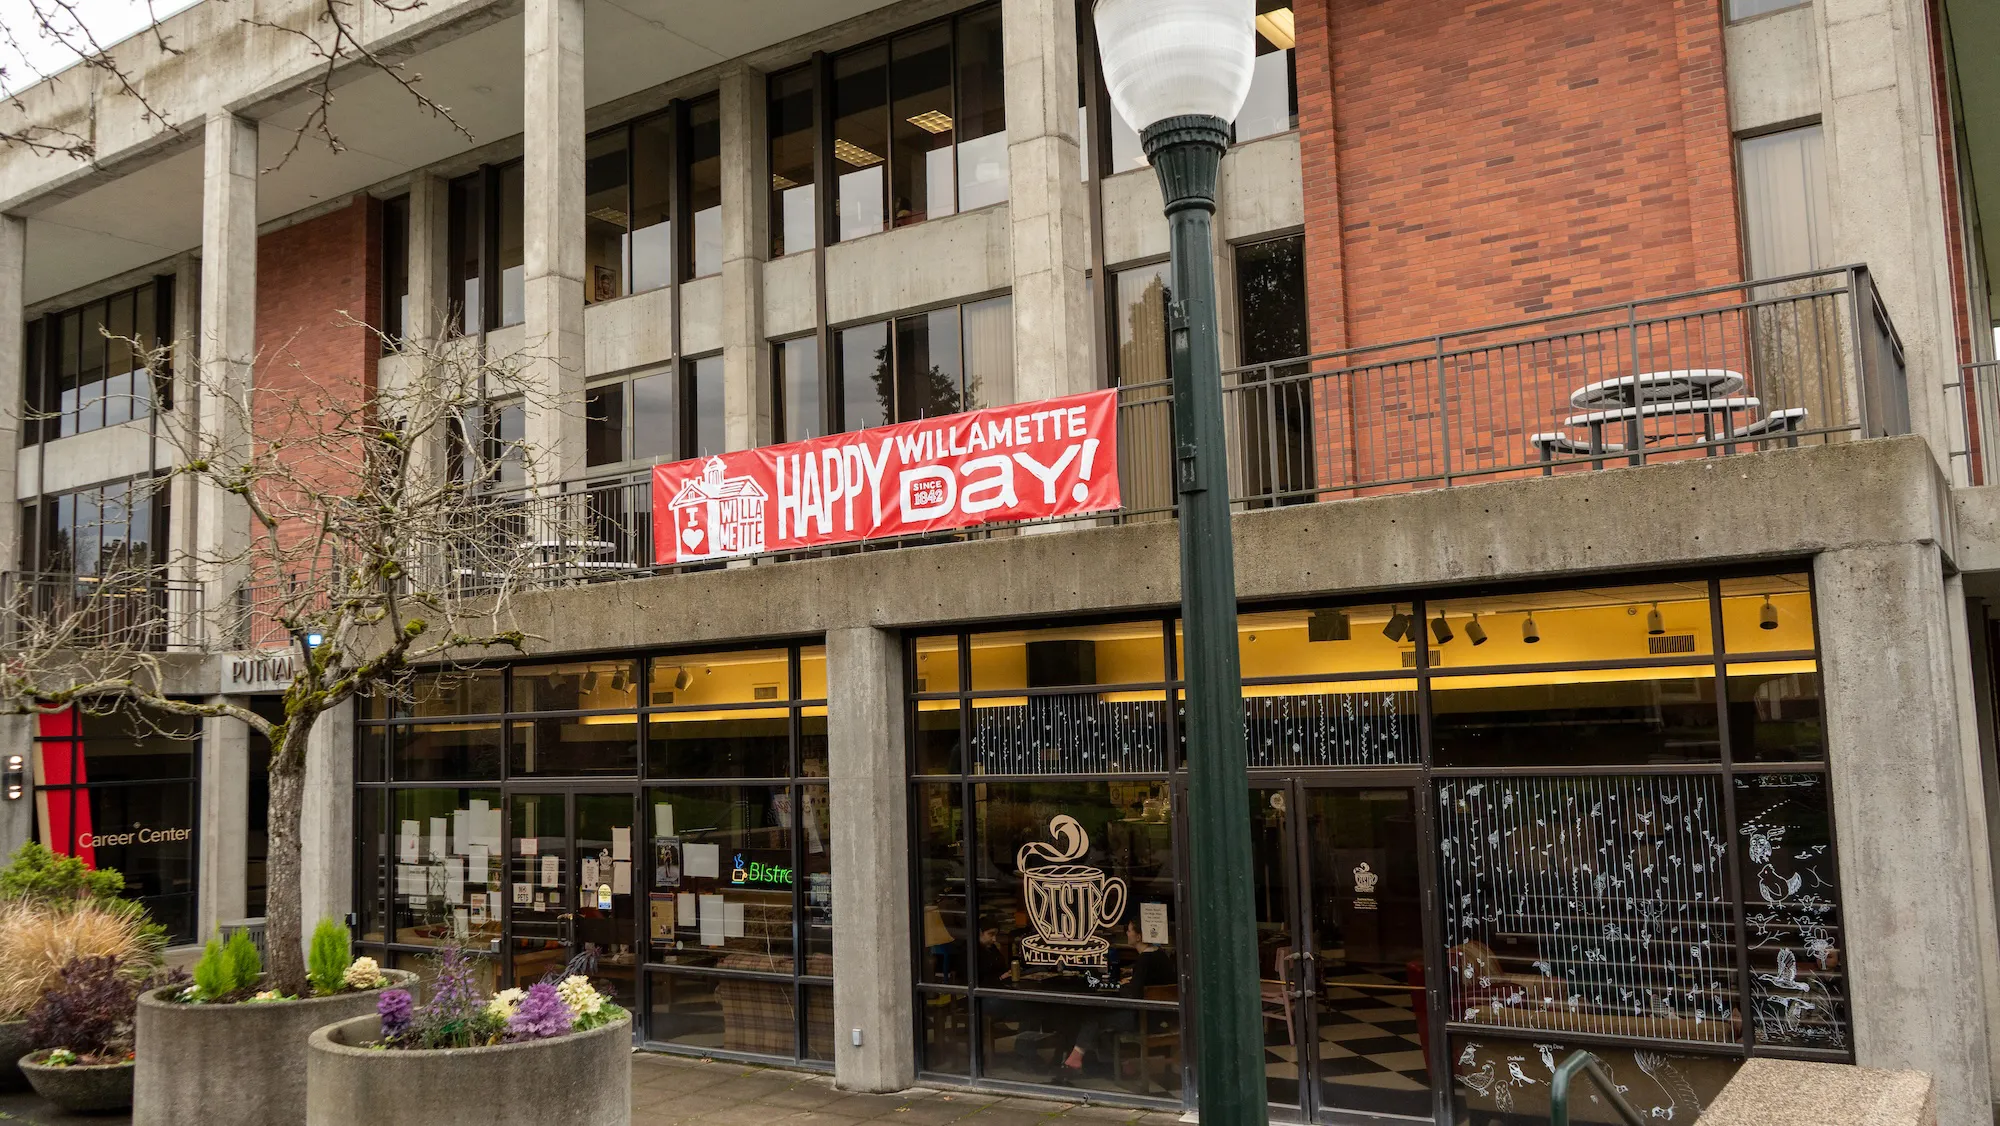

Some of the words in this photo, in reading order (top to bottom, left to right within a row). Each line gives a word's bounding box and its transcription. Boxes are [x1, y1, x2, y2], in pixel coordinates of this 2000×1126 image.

[776, 437, 895, 540] HAPPY
[896, 405, 1087, 464] WILLAMETTE
[913, 480, 943, 491] SINCE
[914, 489, 943, 506] 1842
[685, 507, 699, 528] I
[720, 498, 763, 523] WILLA
[720, 520, 763, 551] METTE
[79, 832, 136, 848] Career
[138, 827, 192, 843] Center
[518, 893, 528, 902] PETS
[1028, 877, 1128, 940] BISTRO
[1022, 945, 1109, 966] WILLAMETTE
